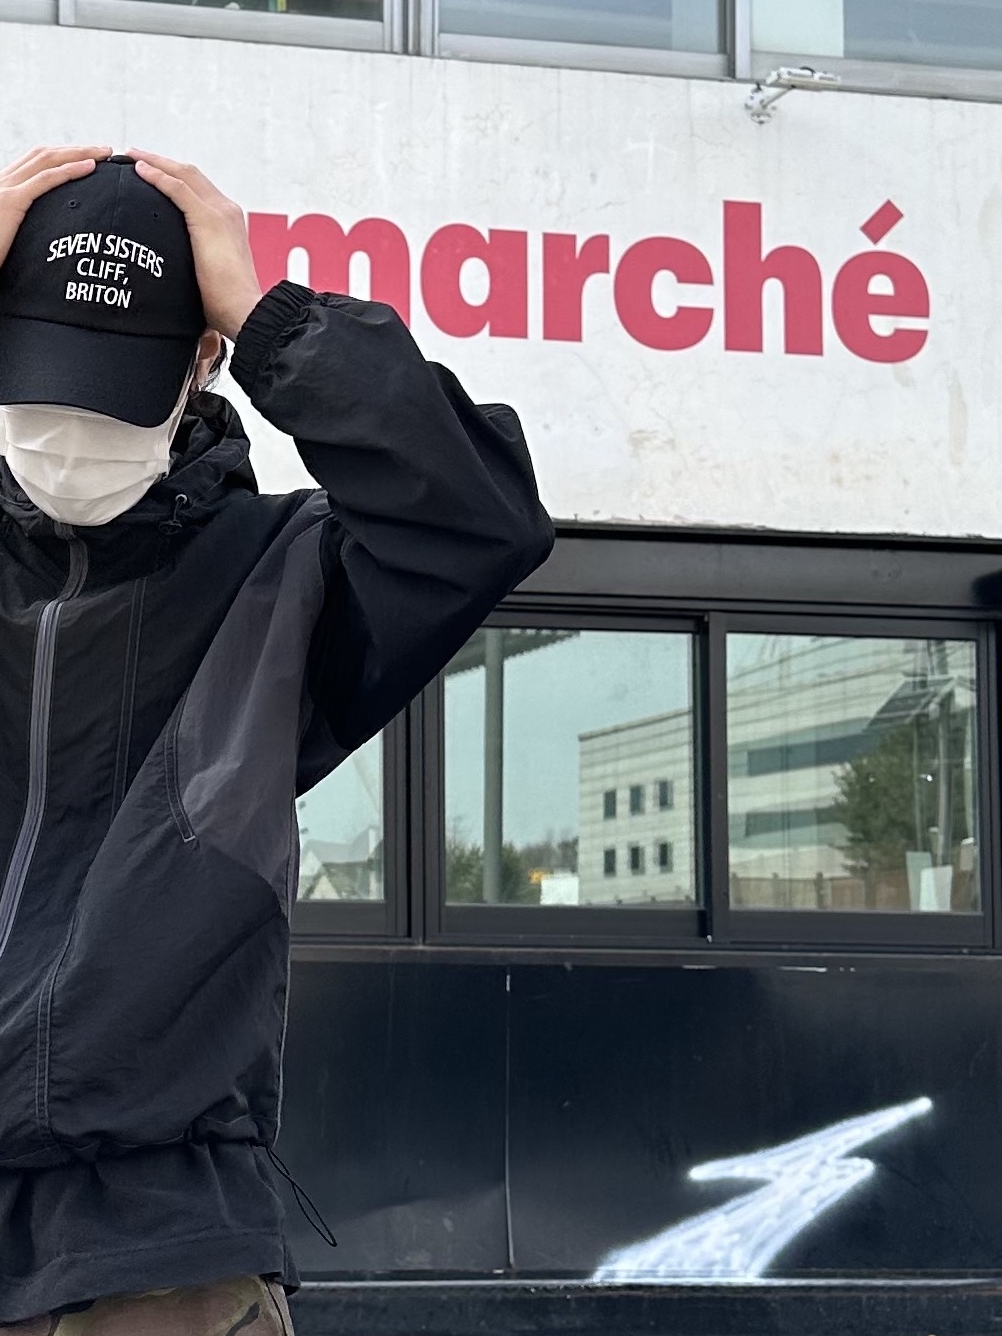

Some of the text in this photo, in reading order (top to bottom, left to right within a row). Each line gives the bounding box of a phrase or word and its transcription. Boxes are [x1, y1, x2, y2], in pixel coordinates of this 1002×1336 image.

[46, 232, 165, 279] SEVEN SISTERS
[75, 257, 129, 286] CLIFF,
[64, 281, 133, 309] BRITON
